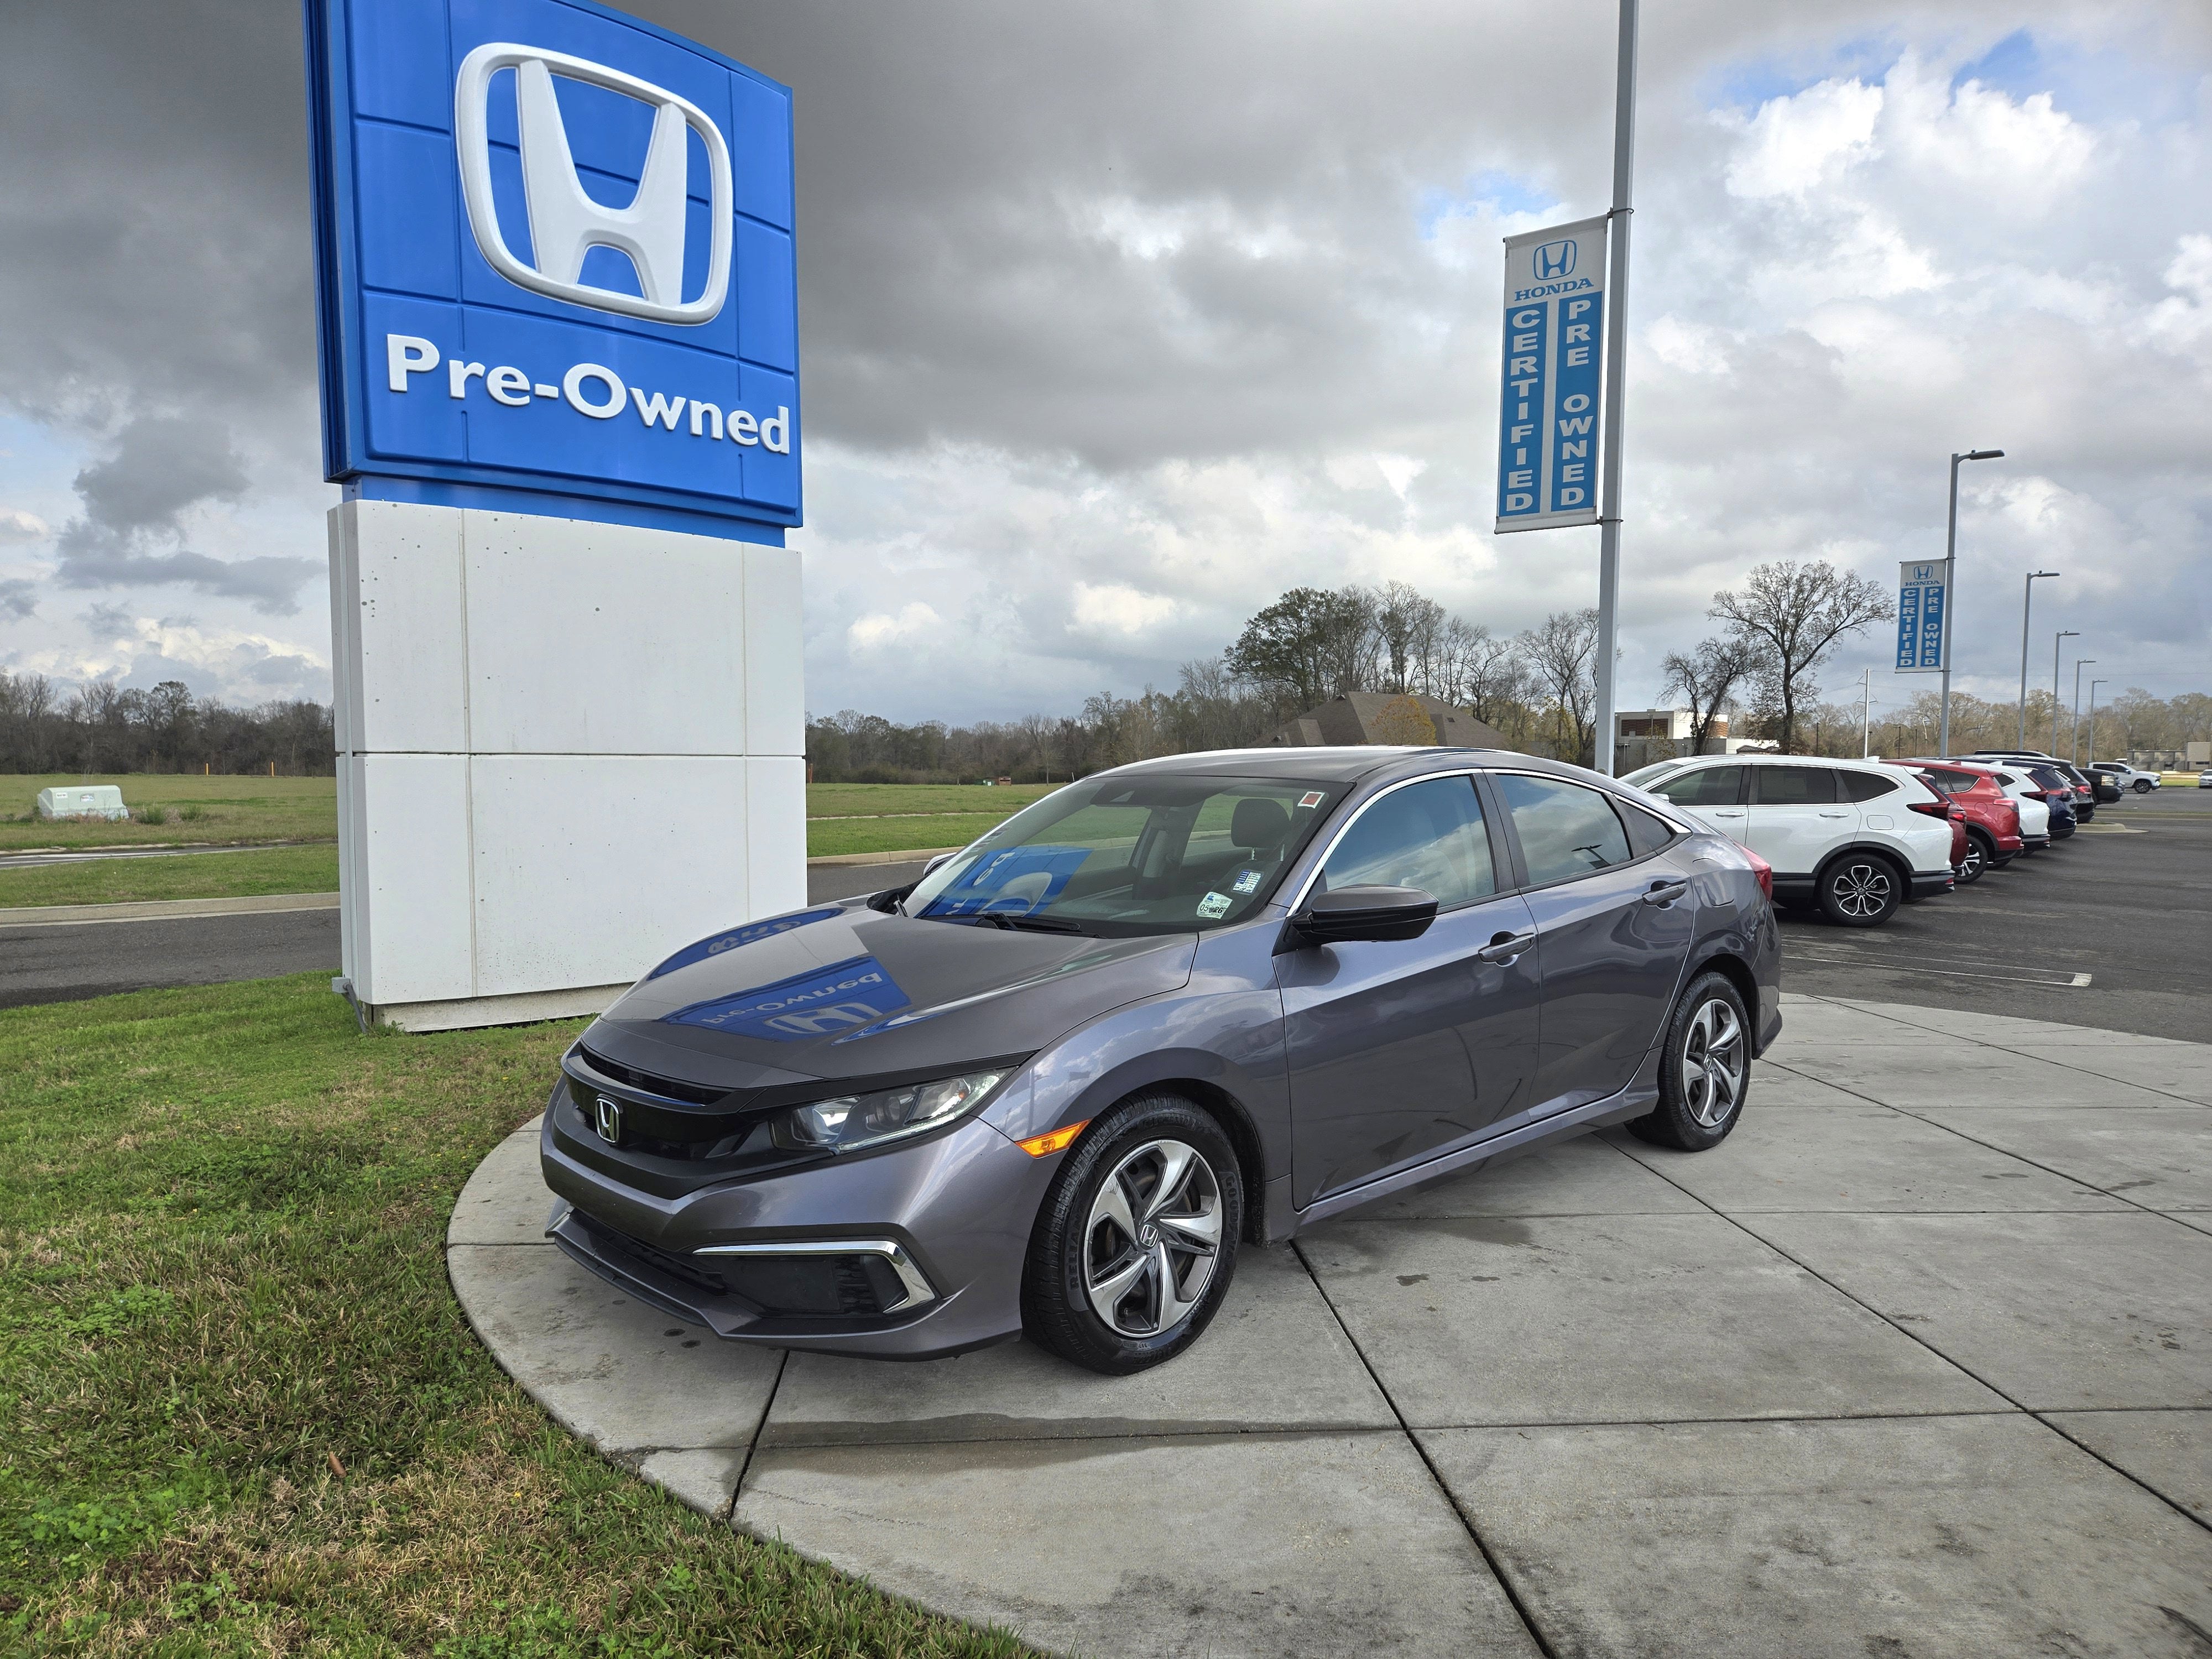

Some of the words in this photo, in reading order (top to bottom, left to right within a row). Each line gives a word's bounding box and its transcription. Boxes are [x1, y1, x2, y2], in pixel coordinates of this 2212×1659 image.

[1514, 278, 1594, 301] HONDA
[1566, 299, 1591, 367] PRE
[387, 333, 790, 455] Pre-Owned
[1506, 309, 1541, 512] CERTIFIED
[1558, 393, 1594, 507] OWNED
[1900, 589, 1917, 666] CERTIFIED
[1928, 588, 1939, 613] PRE
[1924, 623, 1939, 665] OWNED
